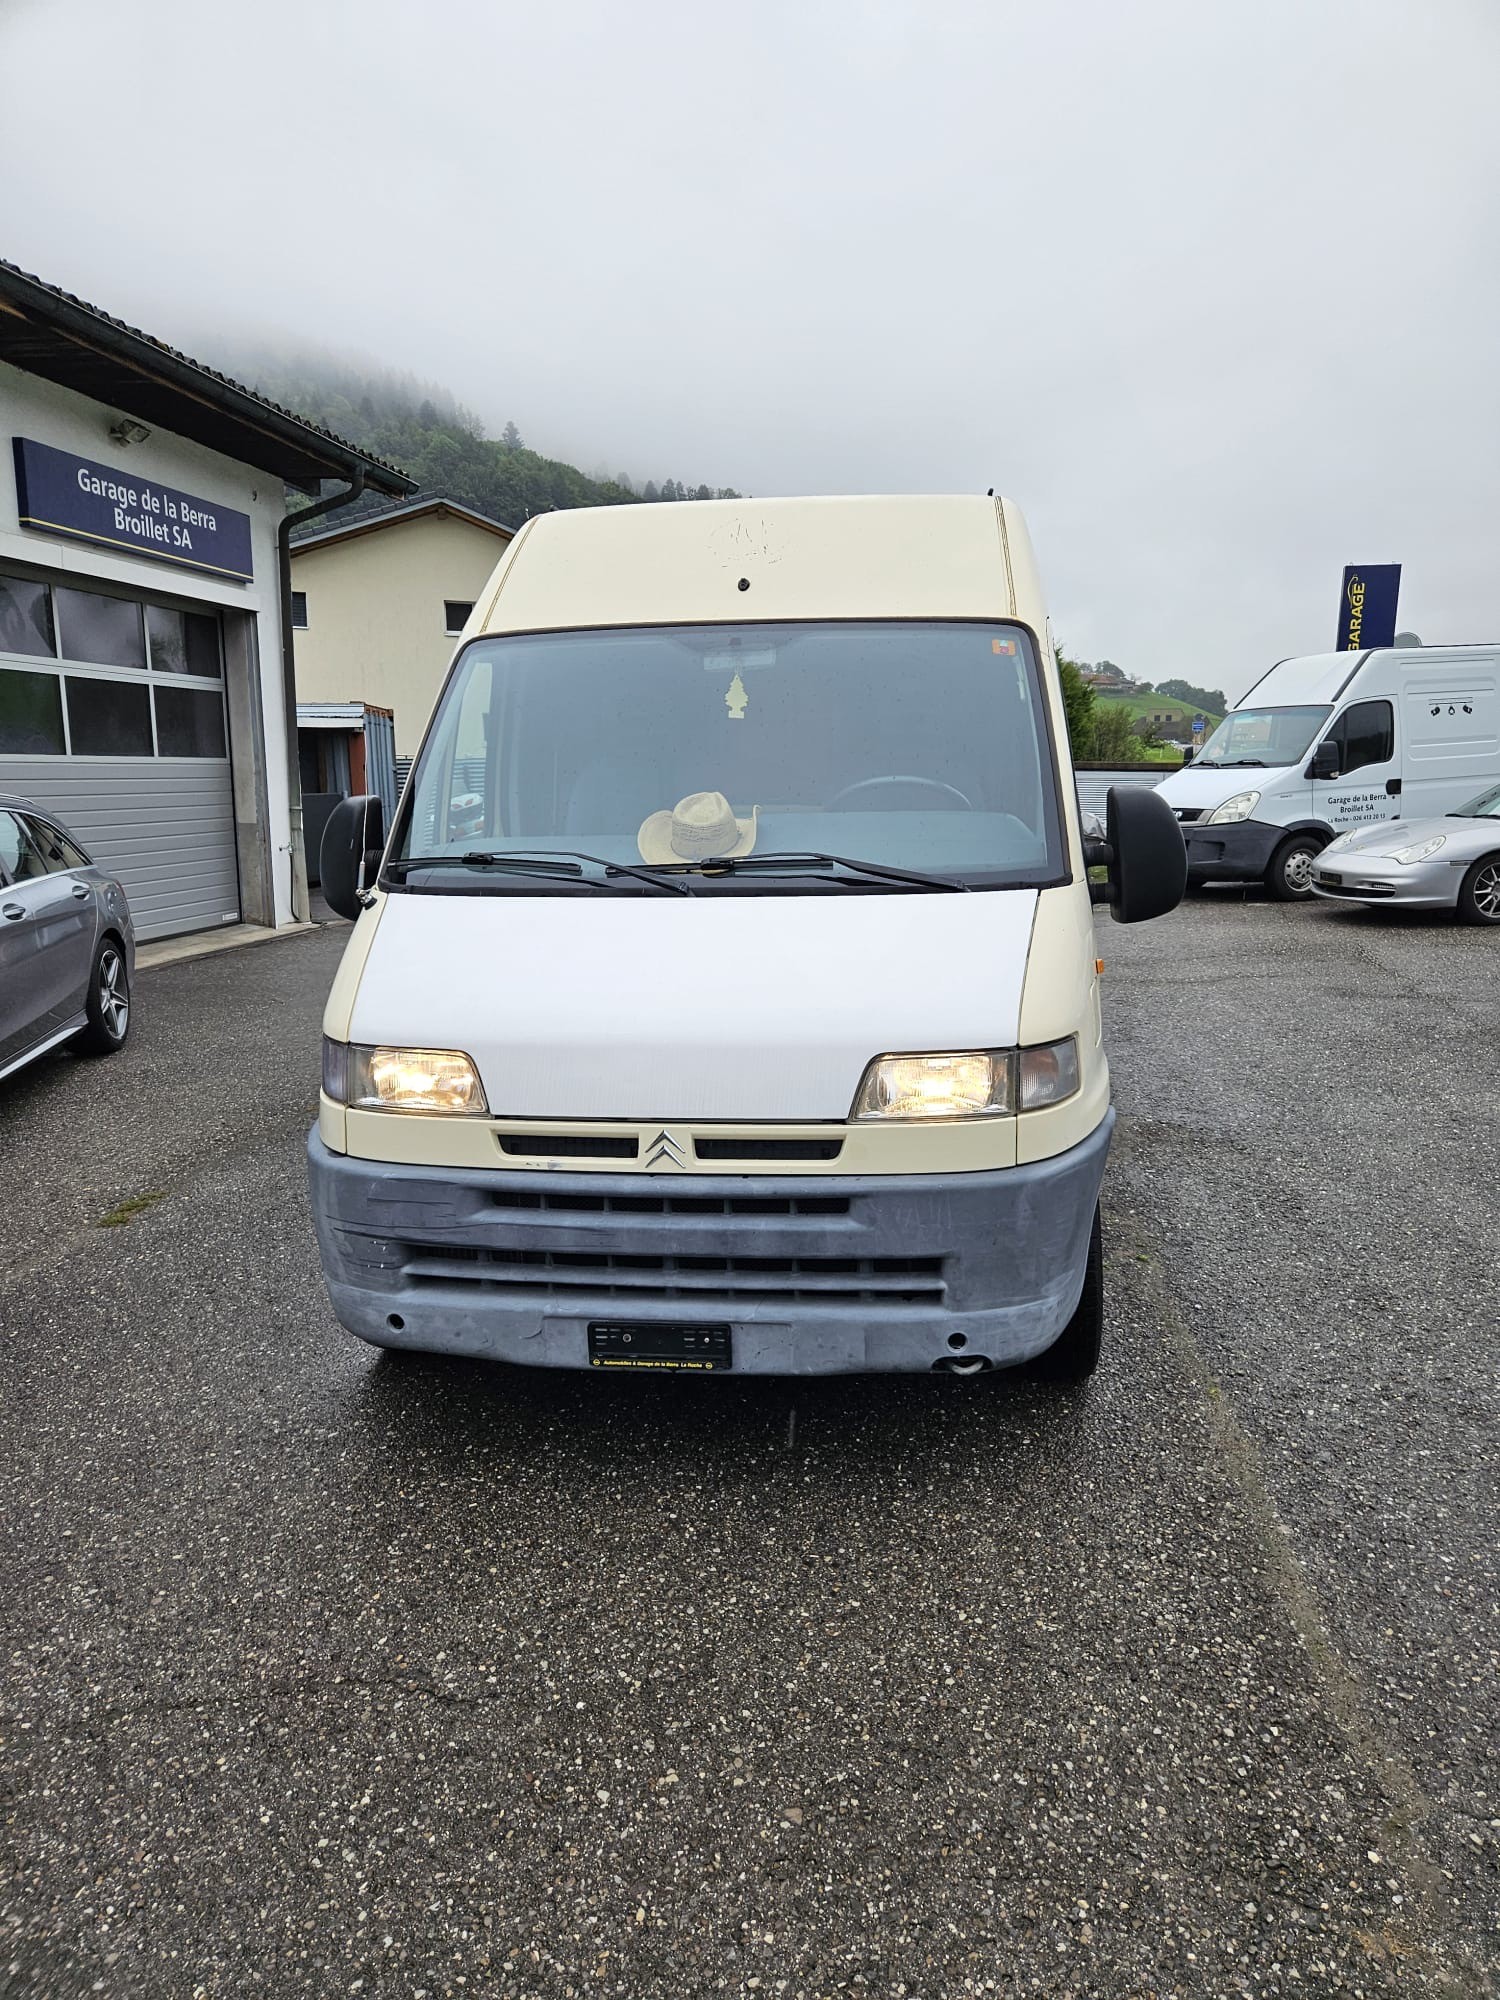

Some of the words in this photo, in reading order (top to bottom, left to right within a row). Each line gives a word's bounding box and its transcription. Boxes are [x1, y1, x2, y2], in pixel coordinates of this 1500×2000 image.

[77, 468, 137, 508] Garage
[141, 488, 160, 514] de
[163, 494, 176, 519] la
[181, 501, 217, 532] Berra
[113, 507, 170, 544] Broillet
[173, 525, 193, 550] SA
[1347, 583, 1365, 651] GARAGE
[1328, 797, 1351, 805] Garage
[1340, 805, 1364, 813] Broillet
[1365, 803, 1374, 811] SA
